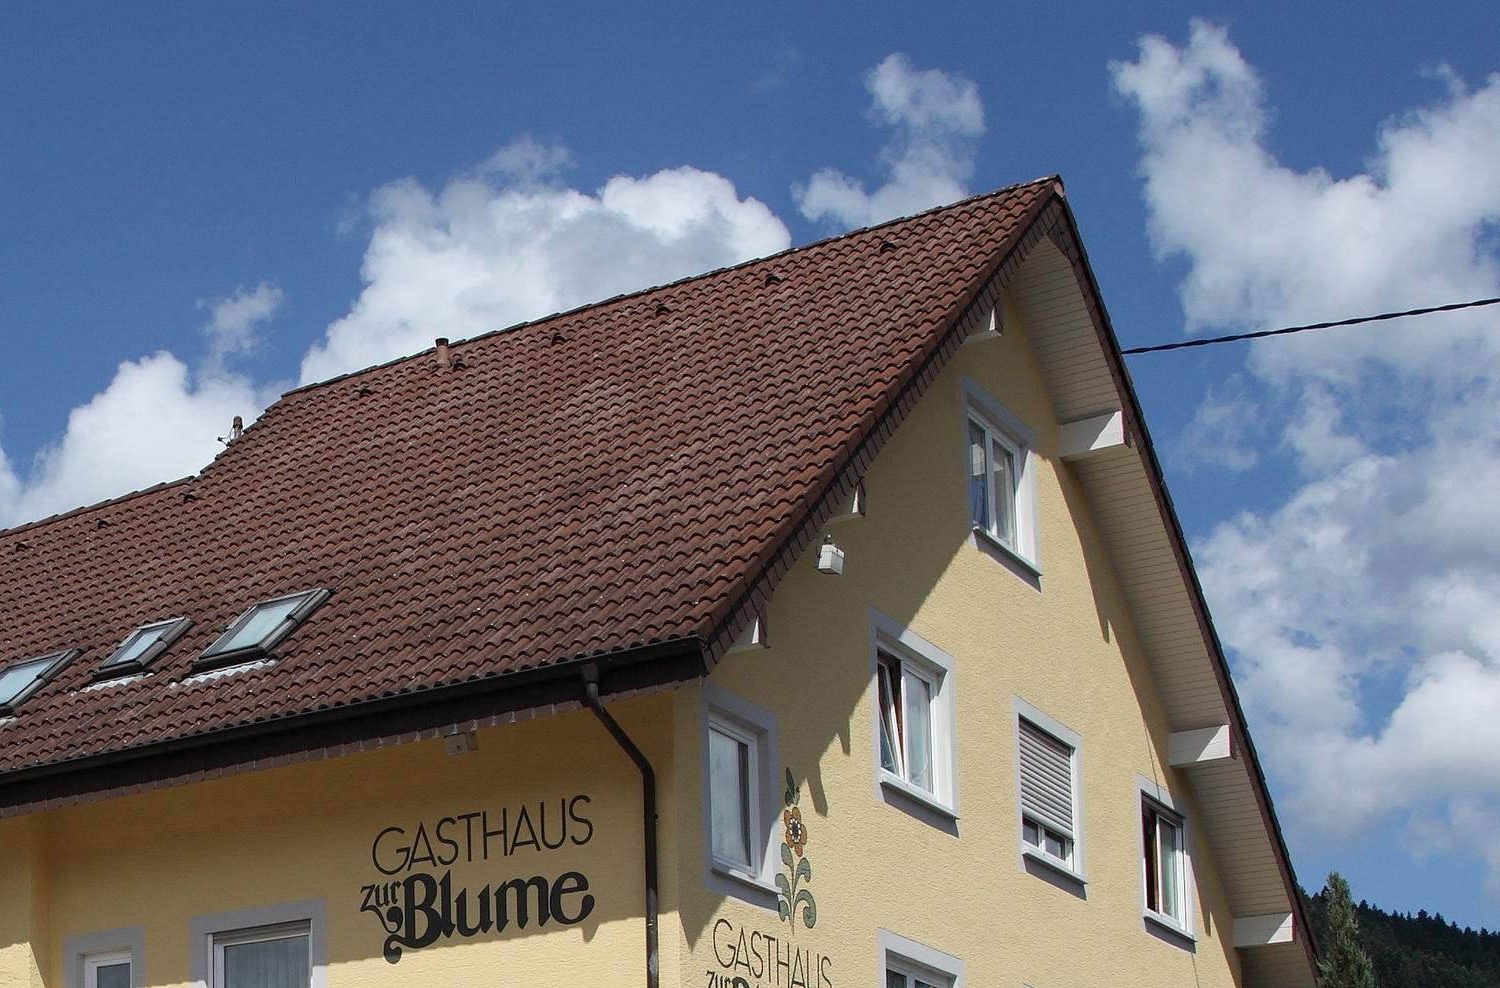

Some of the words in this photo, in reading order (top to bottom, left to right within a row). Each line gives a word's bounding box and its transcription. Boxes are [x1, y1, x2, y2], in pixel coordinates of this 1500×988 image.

[372, 794, 594, 876] GASTHAUS
[359, 879, 403, 932] zur
[384, 869, 596, 965] Blume
